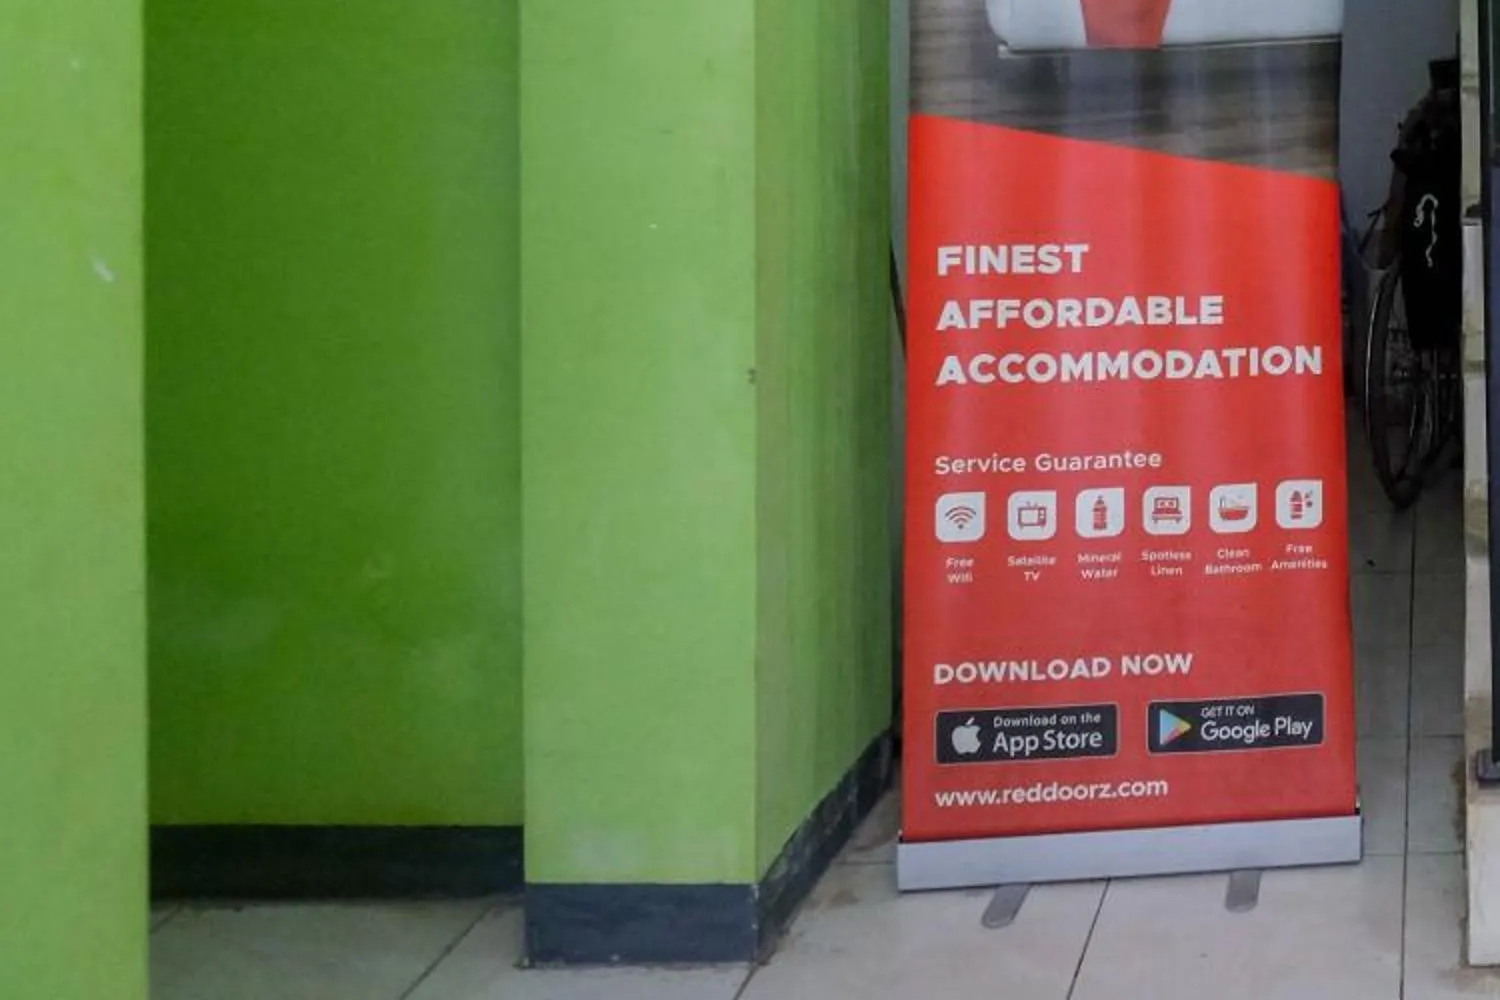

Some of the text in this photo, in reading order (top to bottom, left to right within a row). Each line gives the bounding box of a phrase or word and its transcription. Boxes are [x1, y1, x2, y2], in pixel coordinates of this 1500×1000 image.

[937, 243, 1090, 276] FINEST
[936, 295, 1224, 330] AFFORDABLE
[936, 346, 1322, 385] ACCOMMODATION
[935, 450, 1163, 475] Service Guarantee
[1141, 549, 1192, 562] Spotless
[1217, 547, 1250, 560] Clean
[1286, 543, 1313, 554] Free
[946, 556, 975, 568] Free
[1077, 551, 1121, 564] Mineral
[1271, 557, 1328, 570] Amenities
[1023, 570, 1041, 582] TV
[1081, 567, 1118, 580] Water
[1151, 564, 1183, 577] Linen
[1205, 562, 1262, 576] Bathroom
[934, 653, 1193, 685] DOWNLOAD NOW
[1201, 704, 1255, 718] GET IT ON
[993, 711, 1101, 728] Download on the
[1200, 715, 1313, 744] Google Play
[992, 729, 1103, 757] App Store
[935, 778, 1168, 808] www.reddoorz.com
